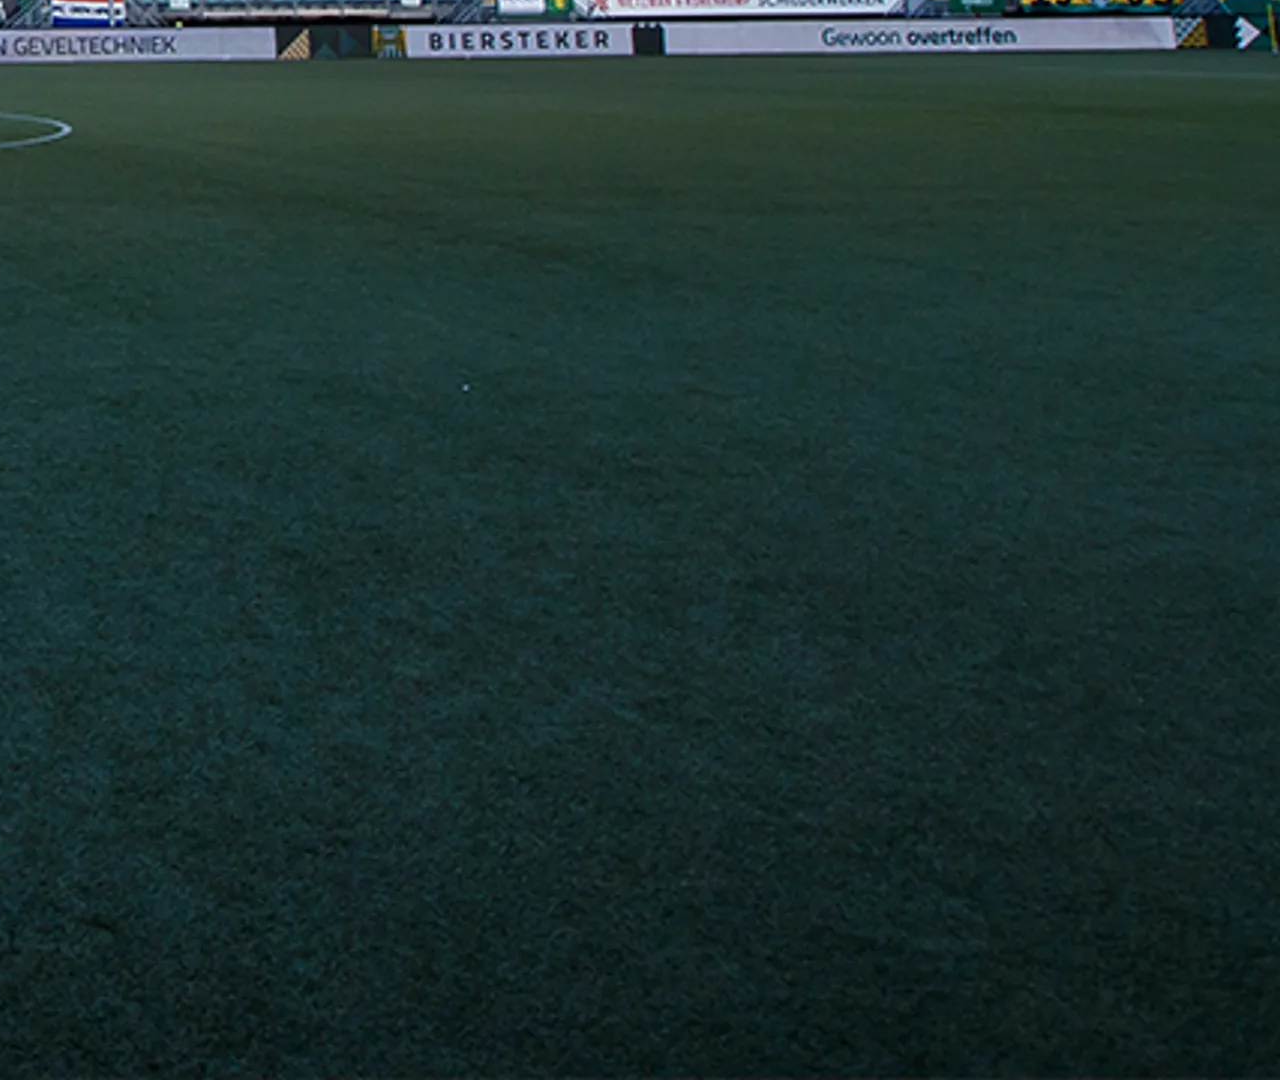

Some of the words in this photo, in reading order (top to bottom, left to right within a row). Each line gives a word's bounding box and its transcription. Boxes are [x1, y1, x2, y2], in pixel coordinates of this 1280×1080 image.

[14, 35, 177, 57] GEVELTECHNIEK
[429, 30, 610, 51] BIERSTEKER
[822, 27, 901, 47] Gewoon
[907, 26, 1017, 46] overtreffen
